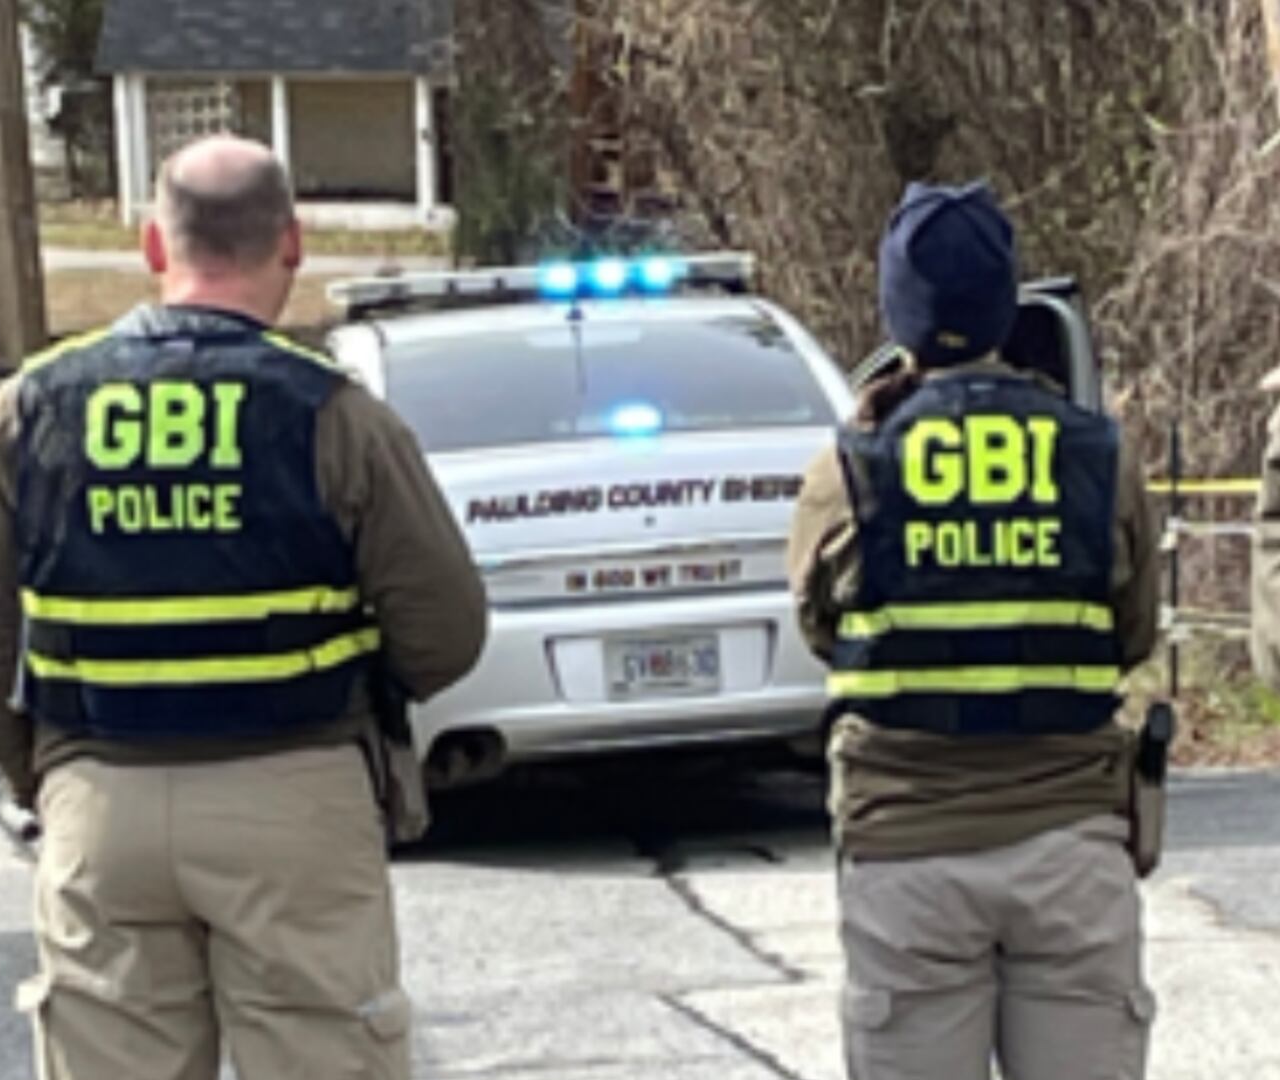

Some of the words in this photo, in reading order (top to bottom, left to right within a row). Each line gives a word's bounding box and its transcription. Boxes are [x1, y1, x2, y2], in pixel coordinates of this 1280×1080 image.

[84, 379, 246, 470] GBI
[900, 414, 1058, 505] GBI
[86, 484, 242, 533] POLICE
[466, 487, 602, 523] PAULDING
[608, 478, 714, 510] COUNTY
[904, 518, 1061, 567] POLICE
